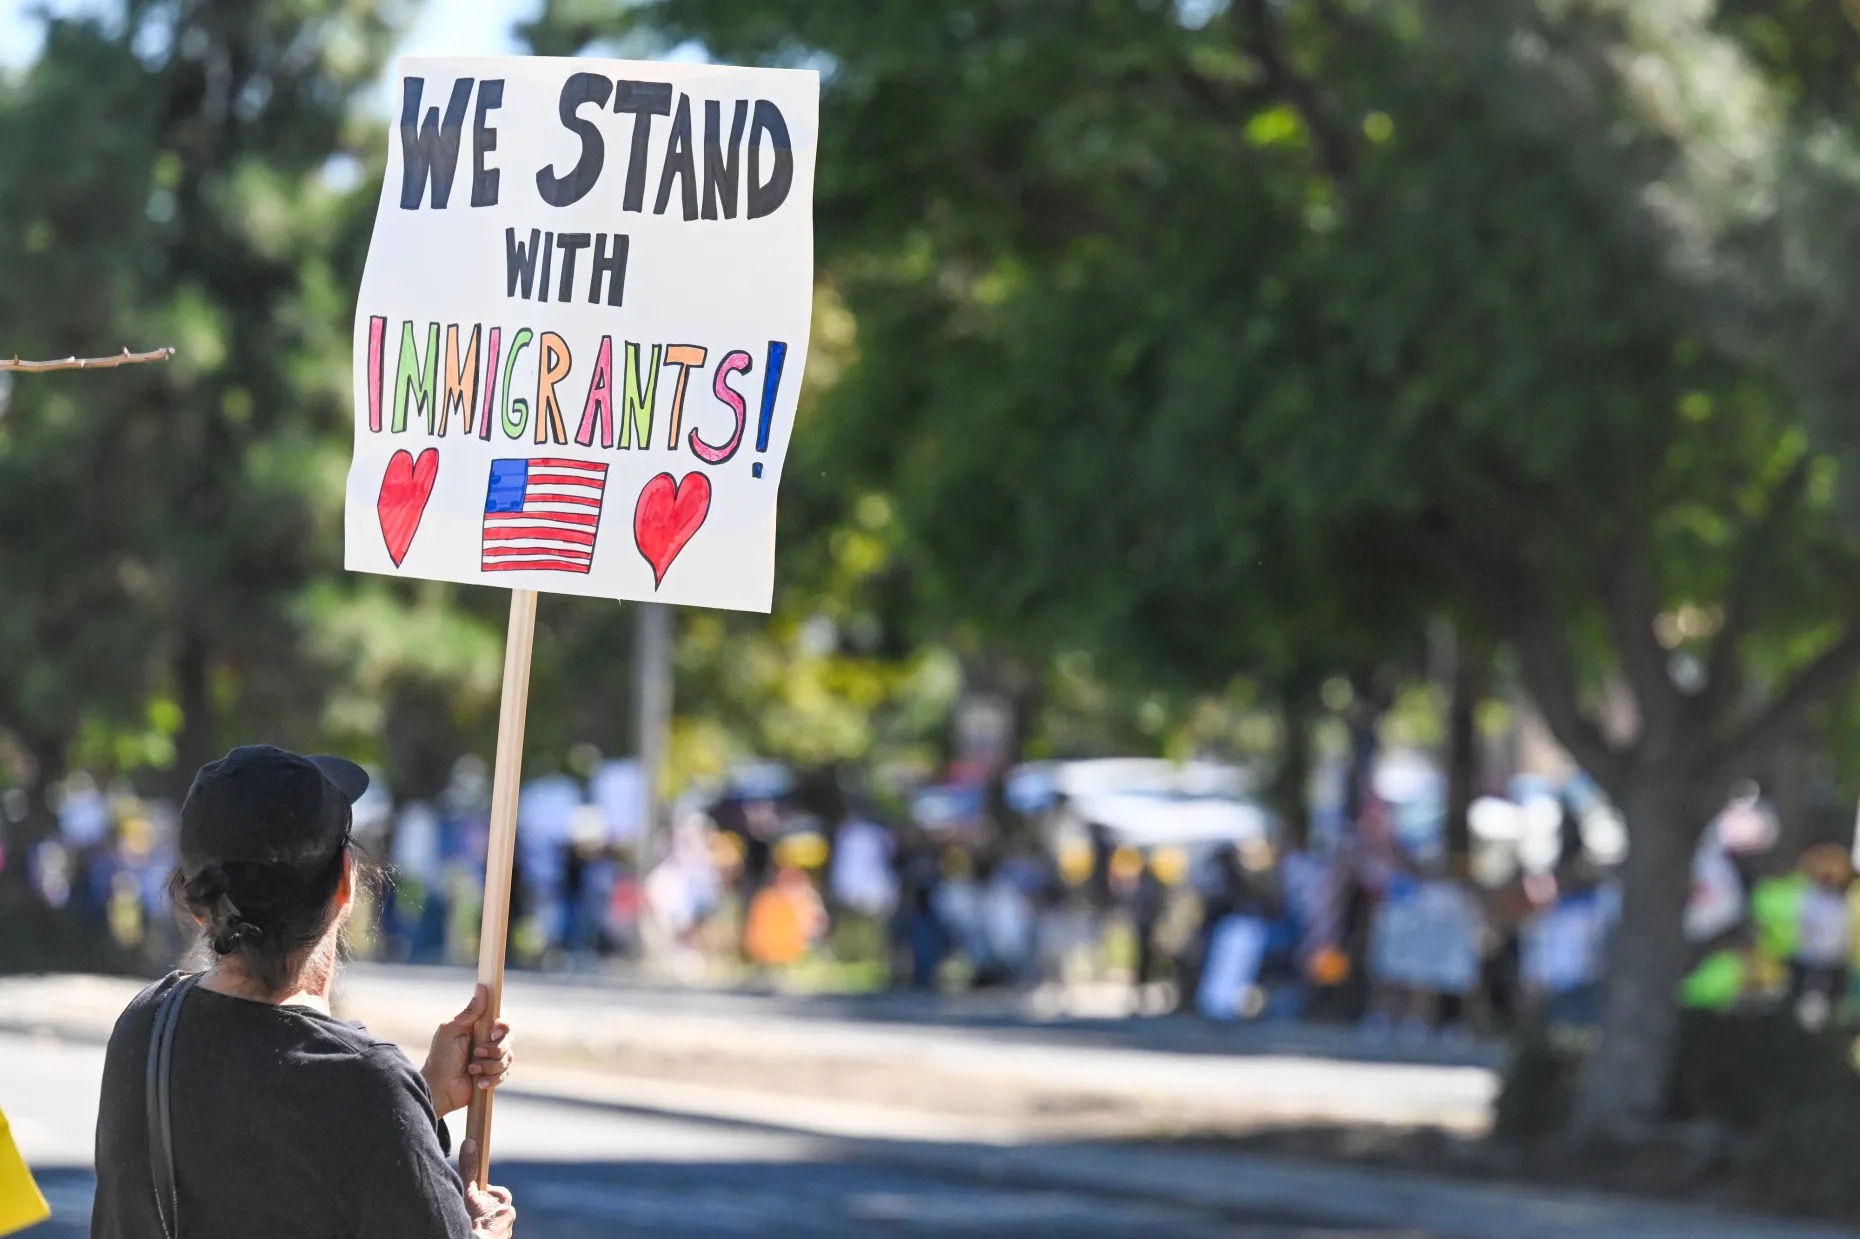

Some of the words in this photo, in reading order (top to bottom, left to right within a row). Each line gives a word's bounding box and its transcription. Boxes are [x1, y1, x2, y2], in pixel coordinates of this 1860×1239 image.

[400, 76, 505, 210] WE
[535, 72, 794, 221] STAND
[505, 227, 629, 307] WITH
[367, 315, 787, 478] IMMIGRANTS!
